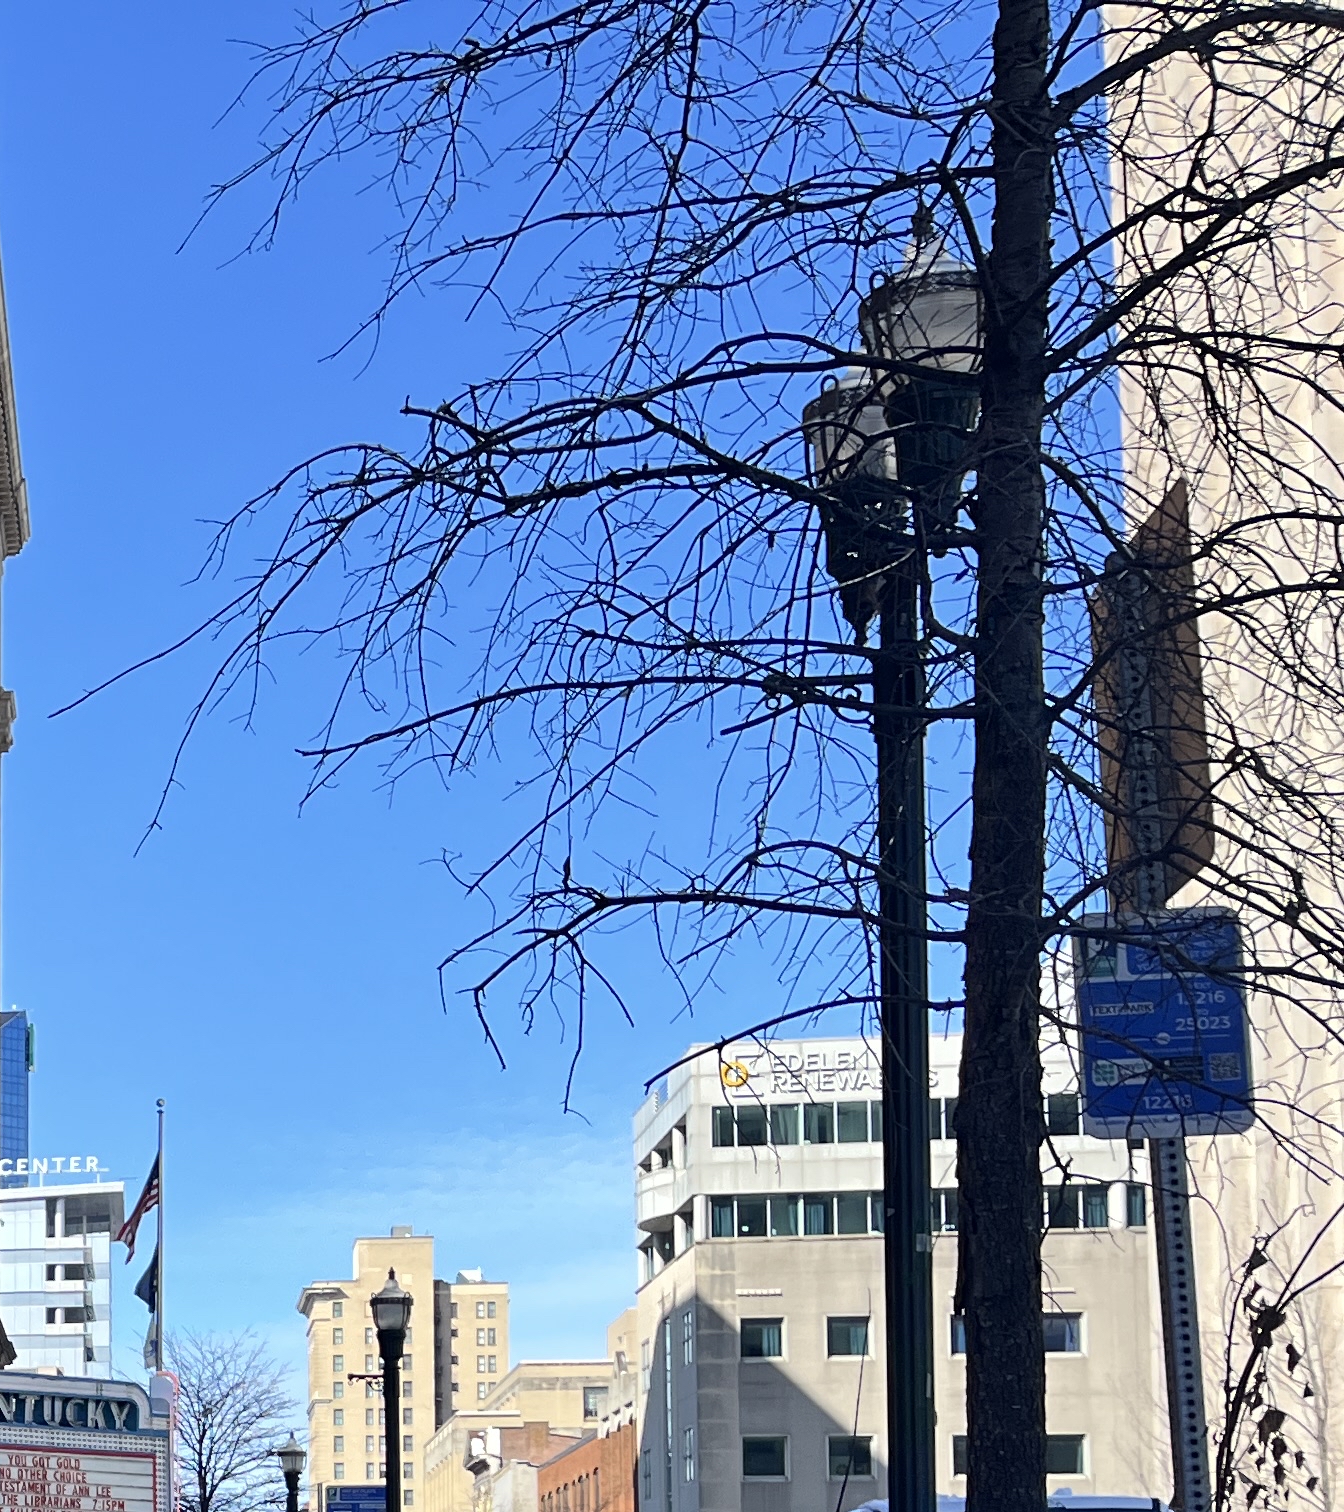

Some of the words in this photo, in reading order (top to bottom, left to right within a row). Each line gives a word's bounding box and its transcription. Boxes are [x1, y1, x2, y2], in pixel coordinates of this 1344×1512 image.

[1176, 991, 1226, 1005] 1216
[1175, 1016, 1231, 1031] 25023
[770, 1070, 940, 1094] RENEWAS
[8, 1454, 27, 1467] YOU
[32, 1456, 50, 1468] GOT
[57, 1457, 80, 1470] GOLD
[0, 1467, 11, 1479] NO
[18, 1468, 47, 1481] OTHER
[54, 1471, 87, 1484] CHOICE
[0, 1481, 51, 1495] TESTAMENT
[56, 1484, 66, 1495] OF
[72, 1486, 90, 1497] ANN
[96, 1486, 111, 1498] LEE
[2, 1493, 18, 1506] THE
[24, 1494, 81, 1509] LIBRARIANS
[92, 1499, 125, 1512] 7:15PM
